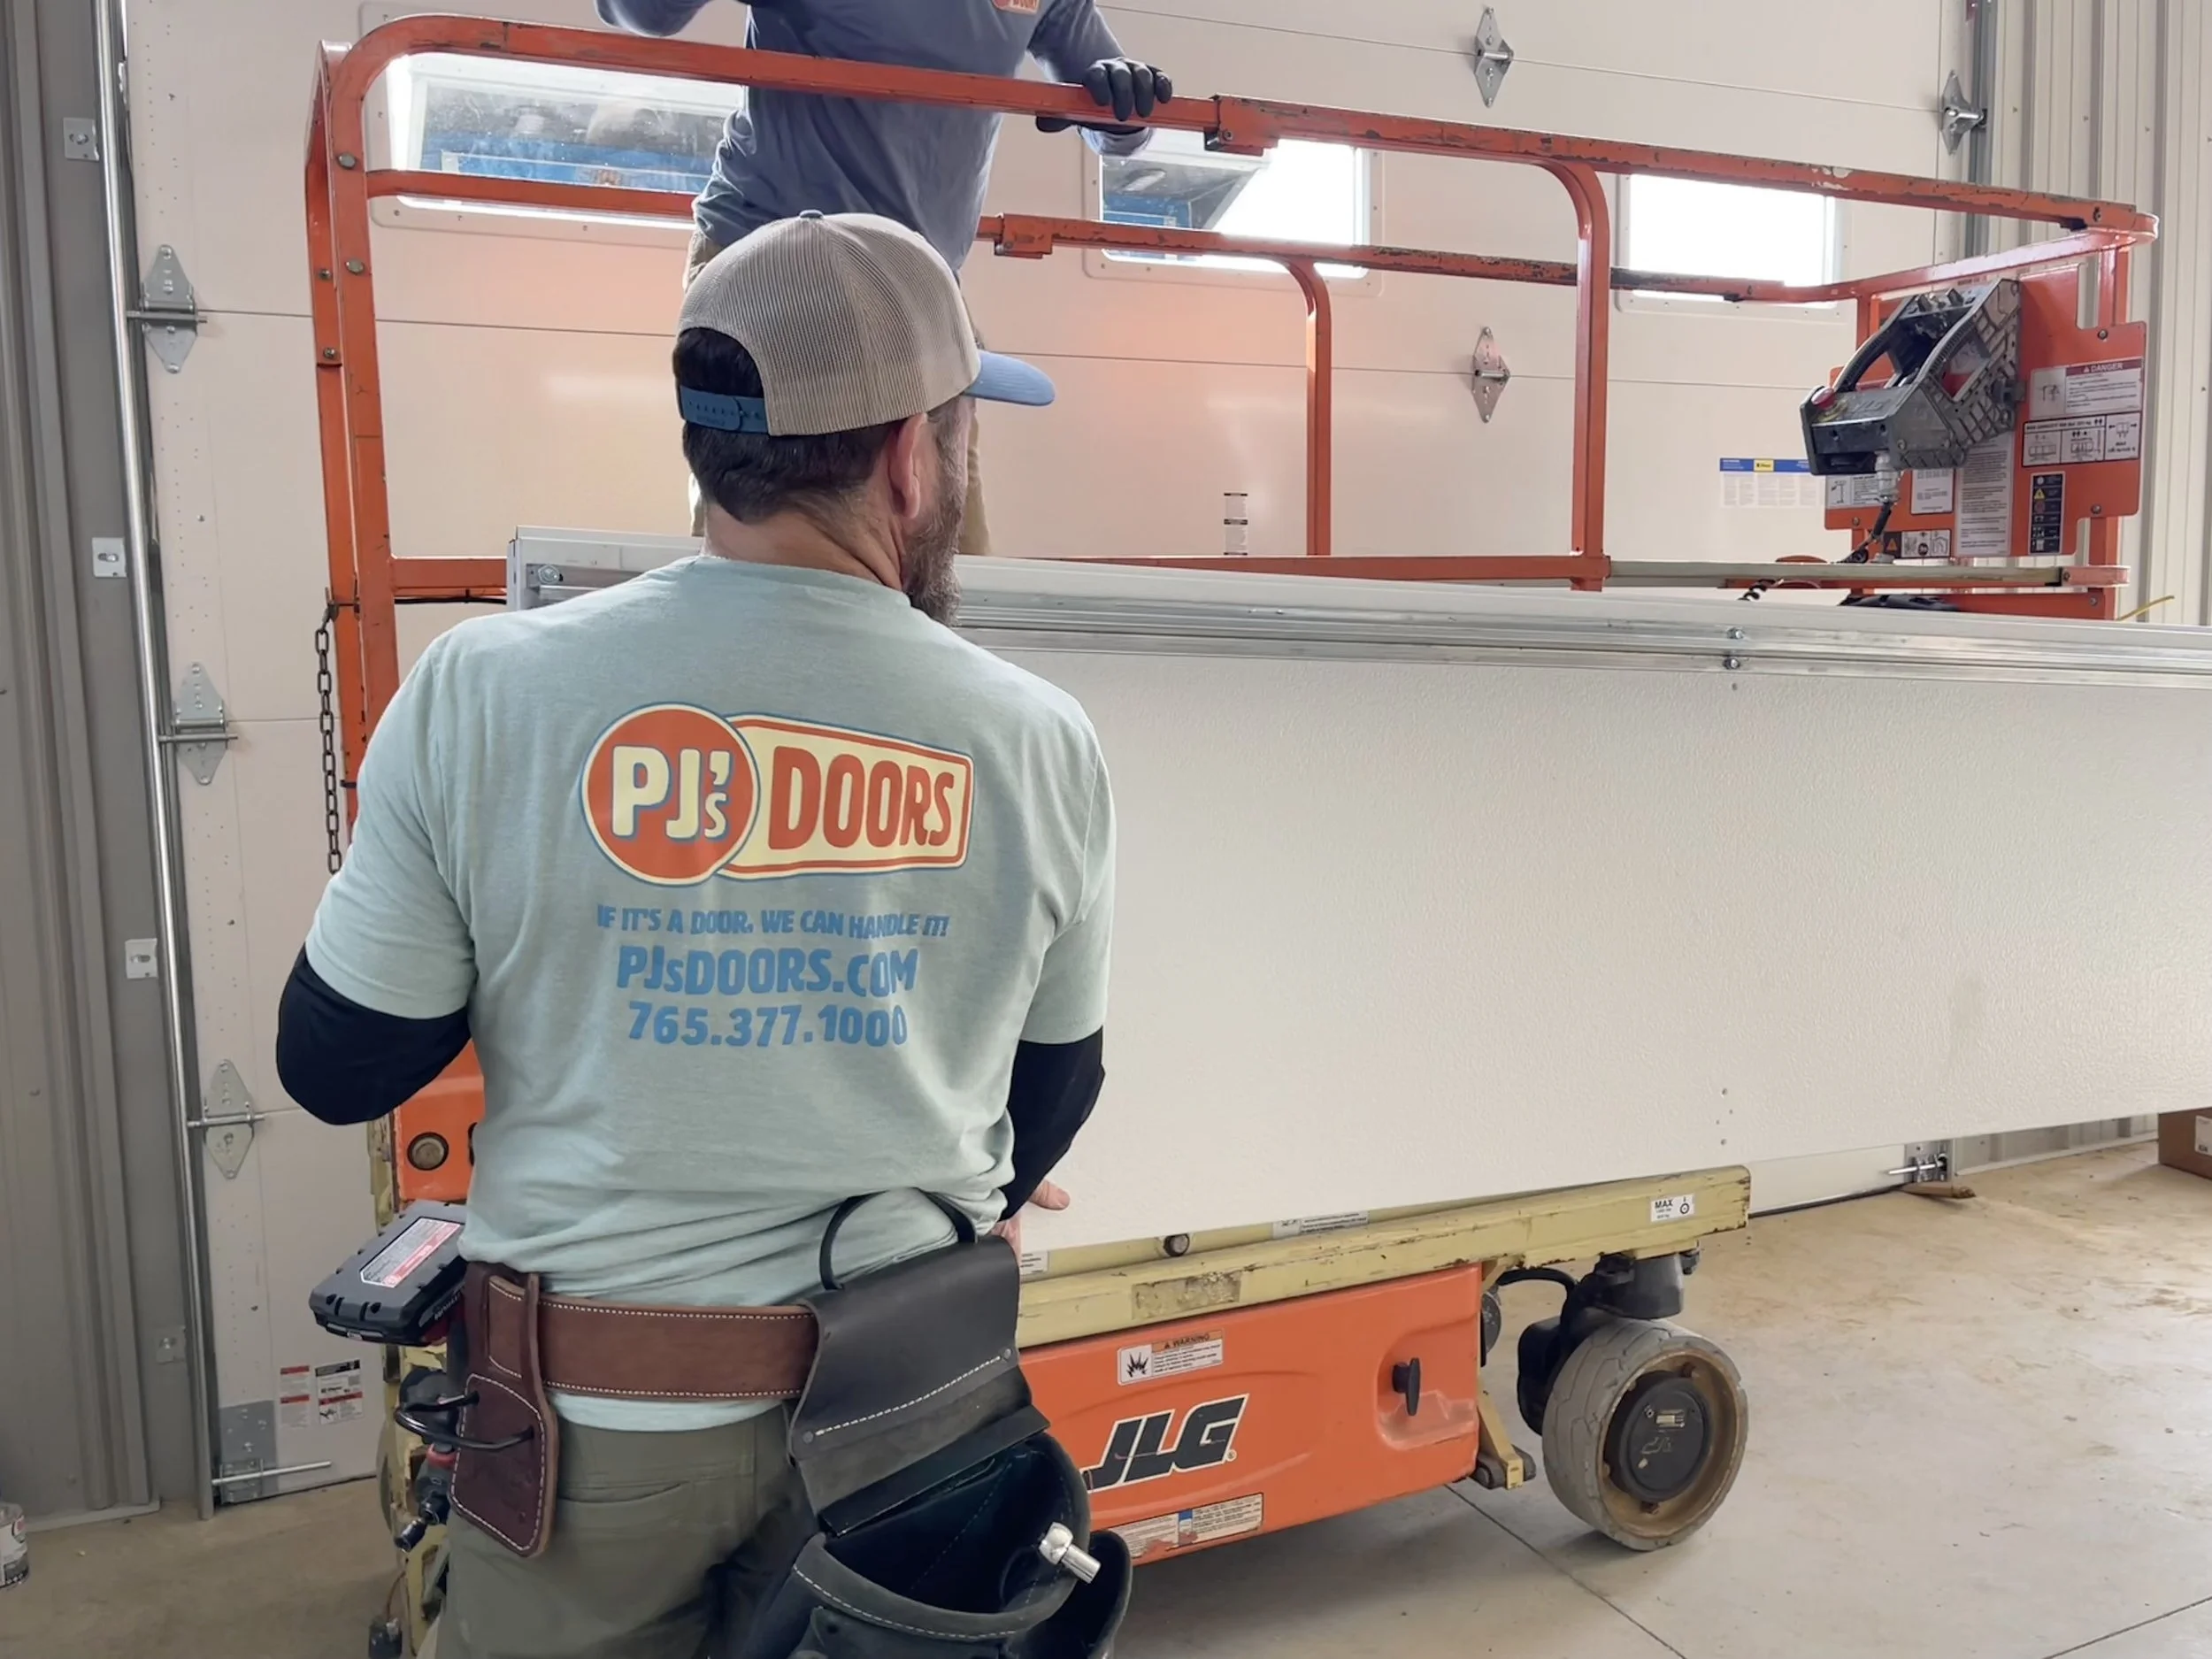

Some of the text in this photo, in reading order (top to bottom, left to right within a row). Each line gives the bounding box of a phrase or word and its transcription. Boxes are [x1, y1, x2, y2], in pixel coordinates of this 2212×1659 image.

[2090, 362, 2124, 373] DANGER
[612, 745, 955, 849] PJ's DOORS
[597, 903, 617, 928] IF
[622, 907, 662, 932] IT'S
[667, 909, 684, 934] A
[761, 910, 795, 934] WE
[800, 910, 844, 936] CAN
[849, 913, 919, 940] HANDLE
[922, 914, 950, 937] IT!
[628, 1001, 908, 1047] 765.377.1000
[1655, 1199, 1673, 1210] MAX
[1172, 1333, 1210, 1348] WARNING
[1080, 1394, 1248, 1493] JLG
